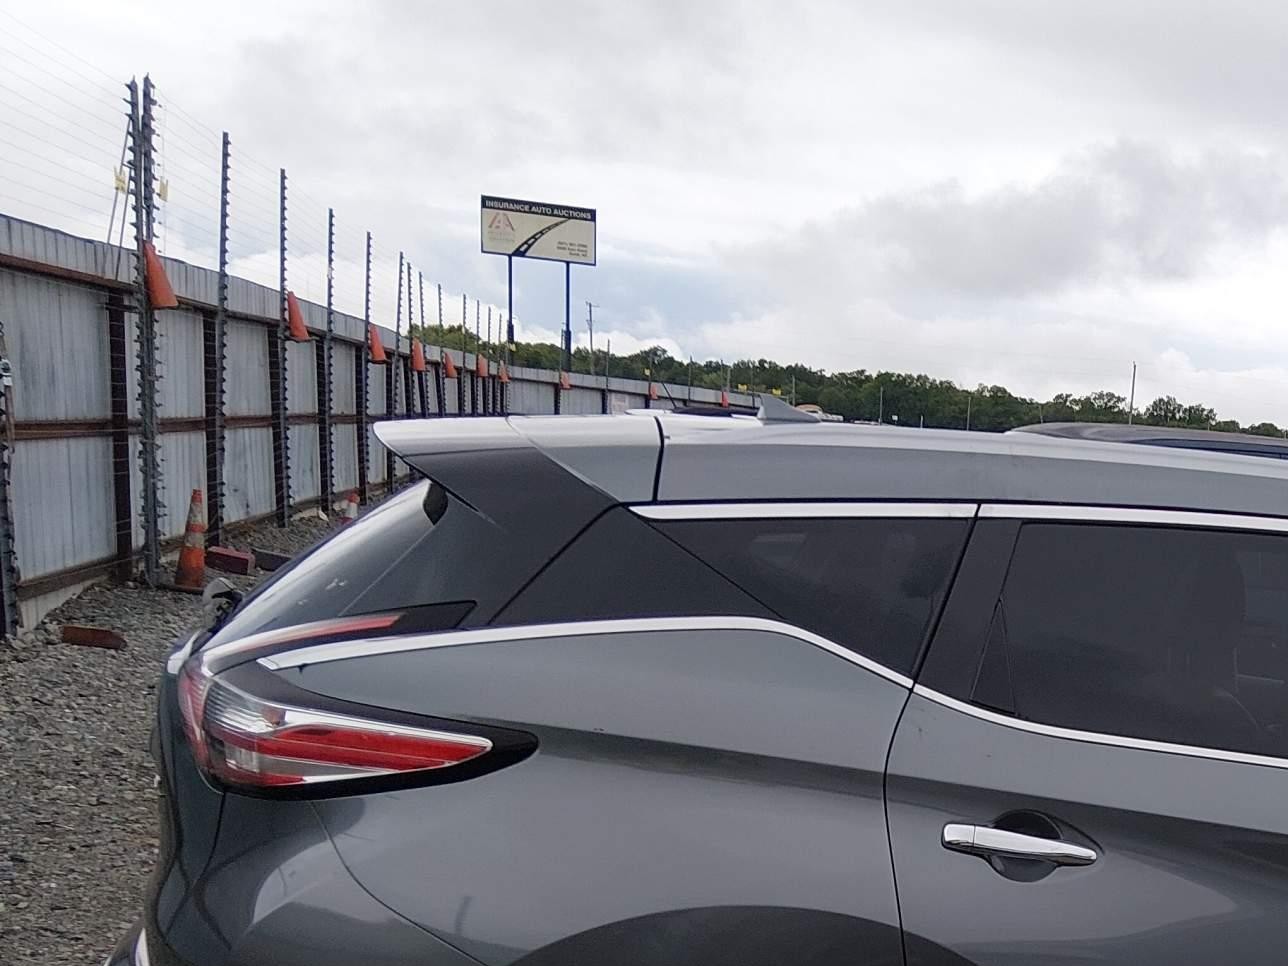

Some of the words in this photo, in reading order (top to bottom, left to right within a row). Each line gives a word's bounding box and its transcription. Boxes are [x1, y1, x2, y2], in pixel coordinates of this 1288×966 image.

[485, 199, 530, 213] INSURANCE
[531, 205, 552, 215] AUTO
[553, 208, 592, 220] AUCTIONS
